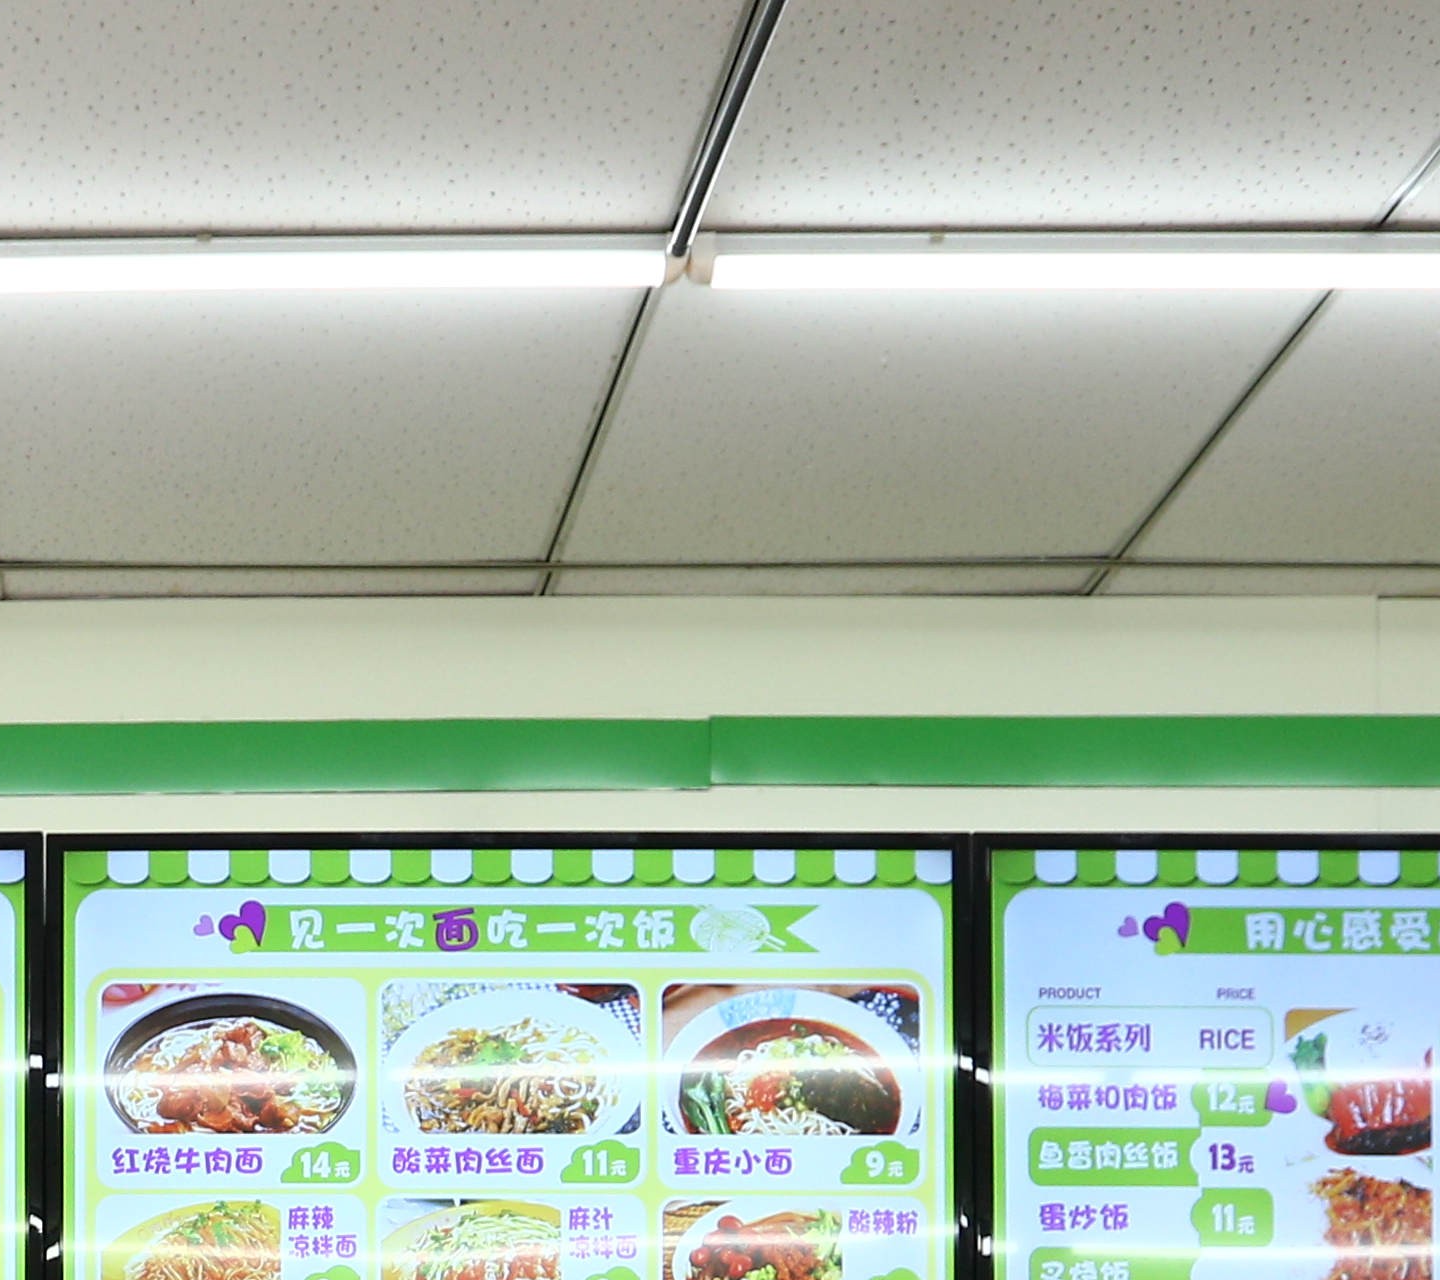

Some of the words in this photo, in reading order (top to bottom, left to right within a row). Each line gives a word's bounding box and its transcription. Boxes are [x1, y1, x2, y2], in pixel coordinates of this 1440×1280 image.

[290, 907, 676, 952] 见一次面吃一次饭
[1039, 987, 1101, 999] PRODUCT
[1217, 988, 1256, 1000] PRICE
[1037, 1023, 1152, 1054] 米饭系列
[1199, 1028, 1256, 1050] RICE
[1037, 1083, 1178, 1113] 梅菜扣肉饭
[1206, 1083, 1256, 1114] 12元
[111, 1146, 264, 1176] 红烧牛肉面
[299, 1149, 351, 1179] 14元
[393, 1146, 545, 1176] 酸菜肉丝面
[582, 1149, 628, 1178] 11元
[673, 1146, 793, 1176] 重庆小面
[865, 1149, 904, 1178] 9元
[1038, 1140, 1180, 1171] 鱼香肉丝饭
[1208, 1143, 1255, 1173] 13元
[288, 1206, 334, 1231] 麻辣
[568, 1207, 613, 1232] 麻汁
[848, 1208, 918, 1236] 酸辣粉
[1039, 1203, 1129, 1232] 蛋炒饭
[1212, 1203, 1256, 1235] 11元
[288, 1233, 358, 1260] 凉拌面
